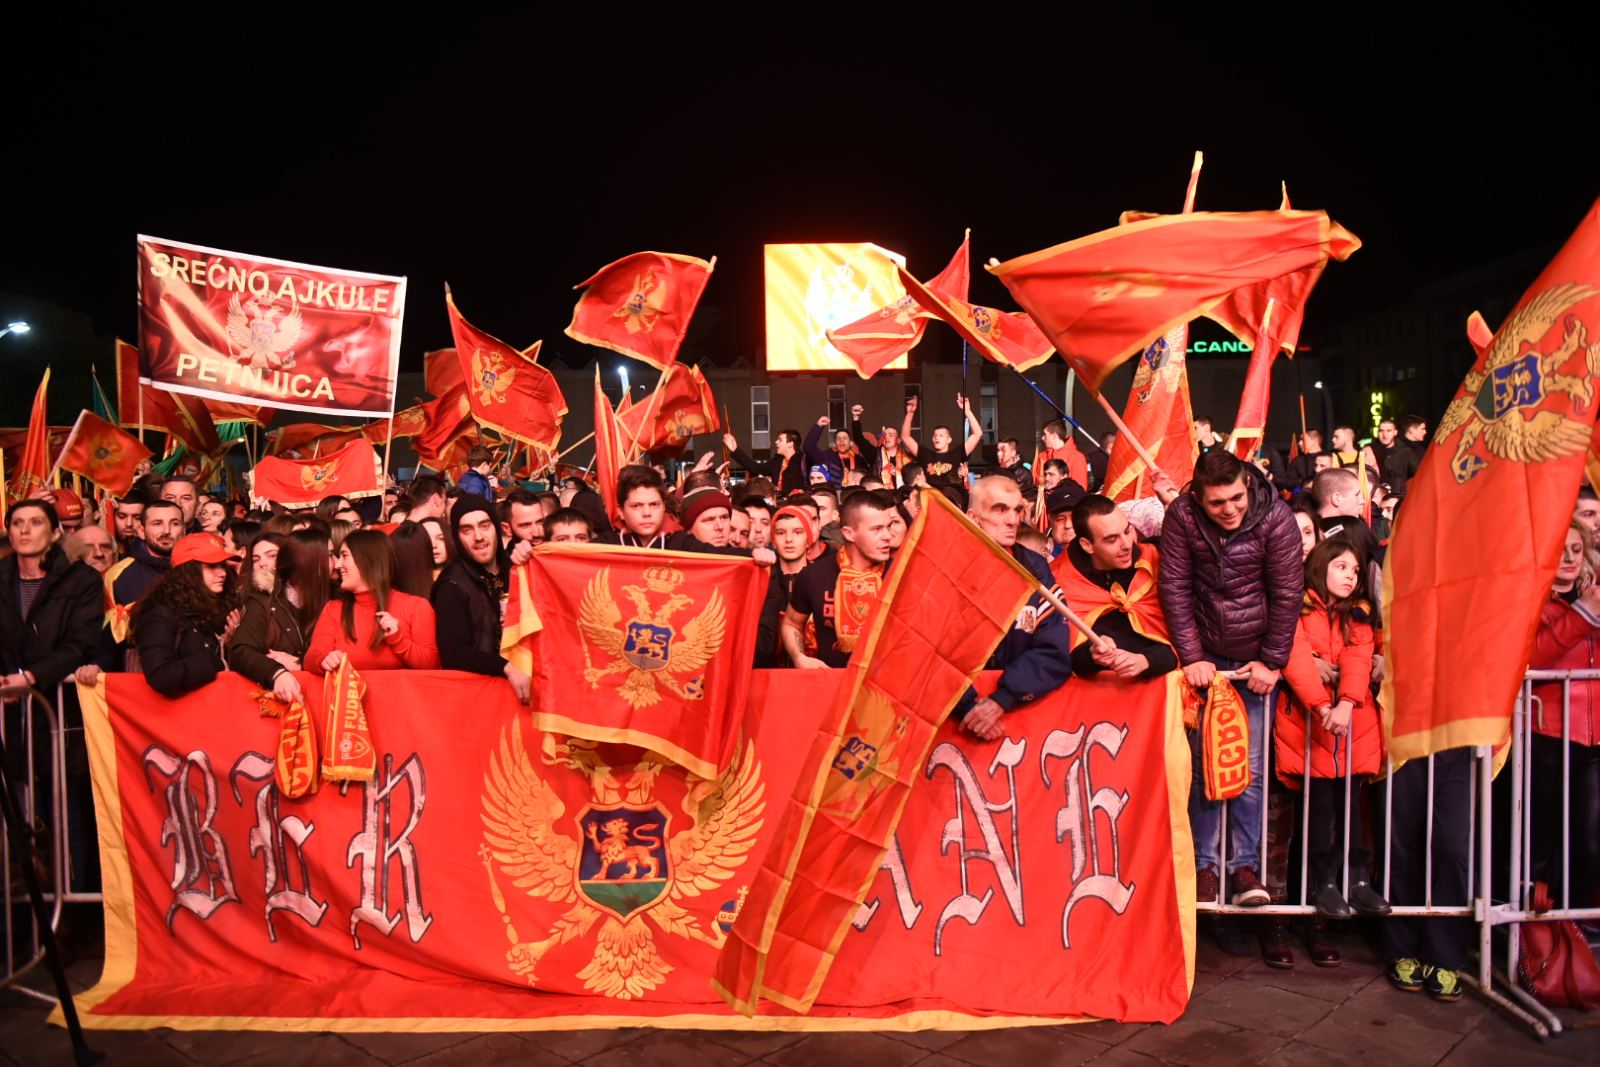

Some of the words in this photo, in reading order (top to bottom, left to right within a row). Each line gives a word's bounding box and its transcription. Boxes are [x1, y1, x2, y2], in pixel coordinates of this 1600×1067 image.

[151, 252, 270, 296] SREĆNO
[275, 276, 390, 312] AJKULE
[176, 353, 335, 401] PETNJICA
[345, 673, 361, 730] FUDBA
